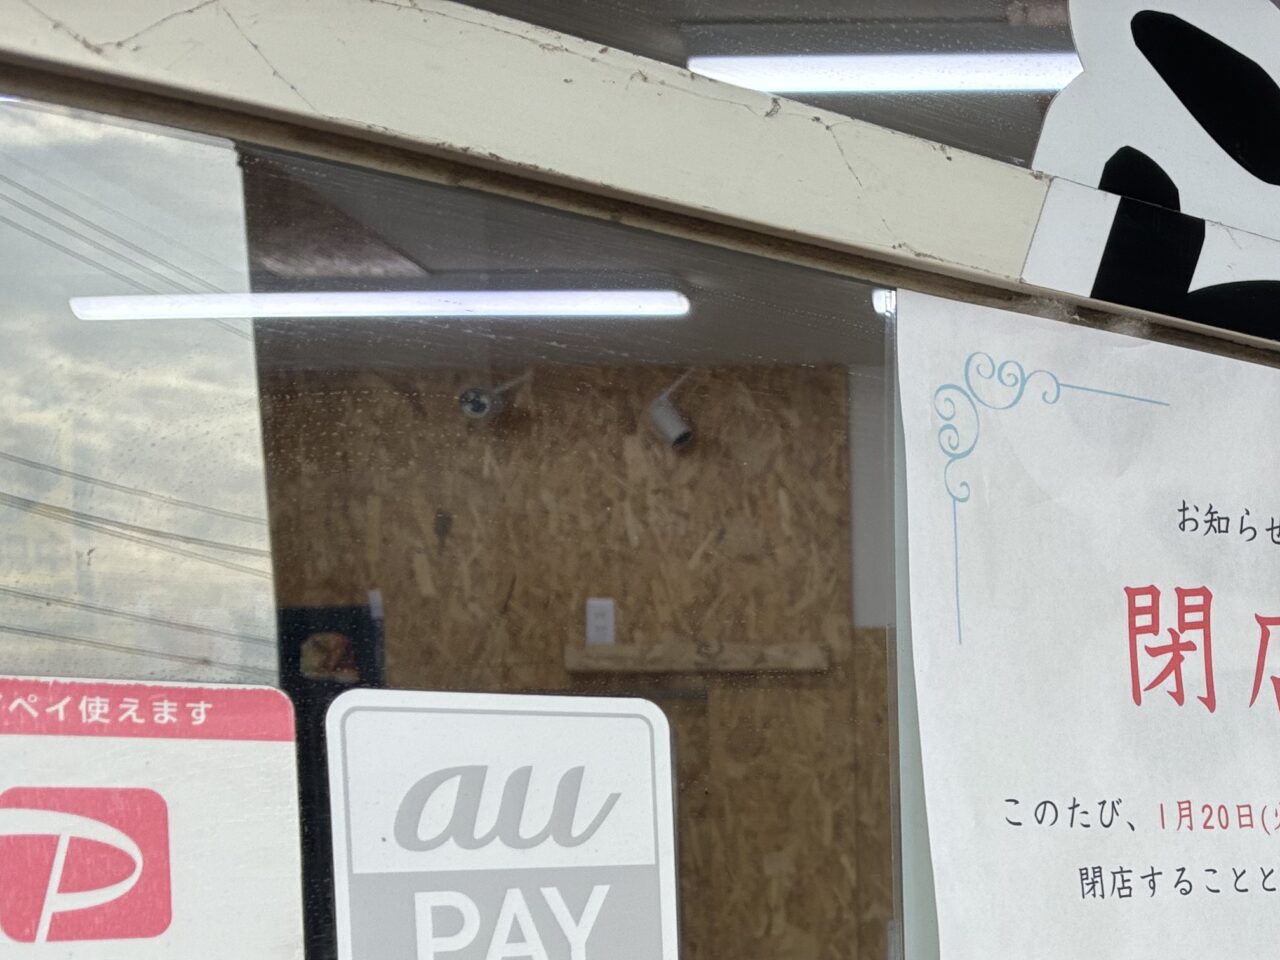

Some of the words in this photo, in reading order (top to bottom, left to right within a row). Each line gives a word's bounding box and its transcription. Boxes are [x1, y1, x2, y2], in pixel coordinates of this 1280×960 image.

[8, 694, 213, 726] ペイ使えます
[392, 764, 623, 851] au
